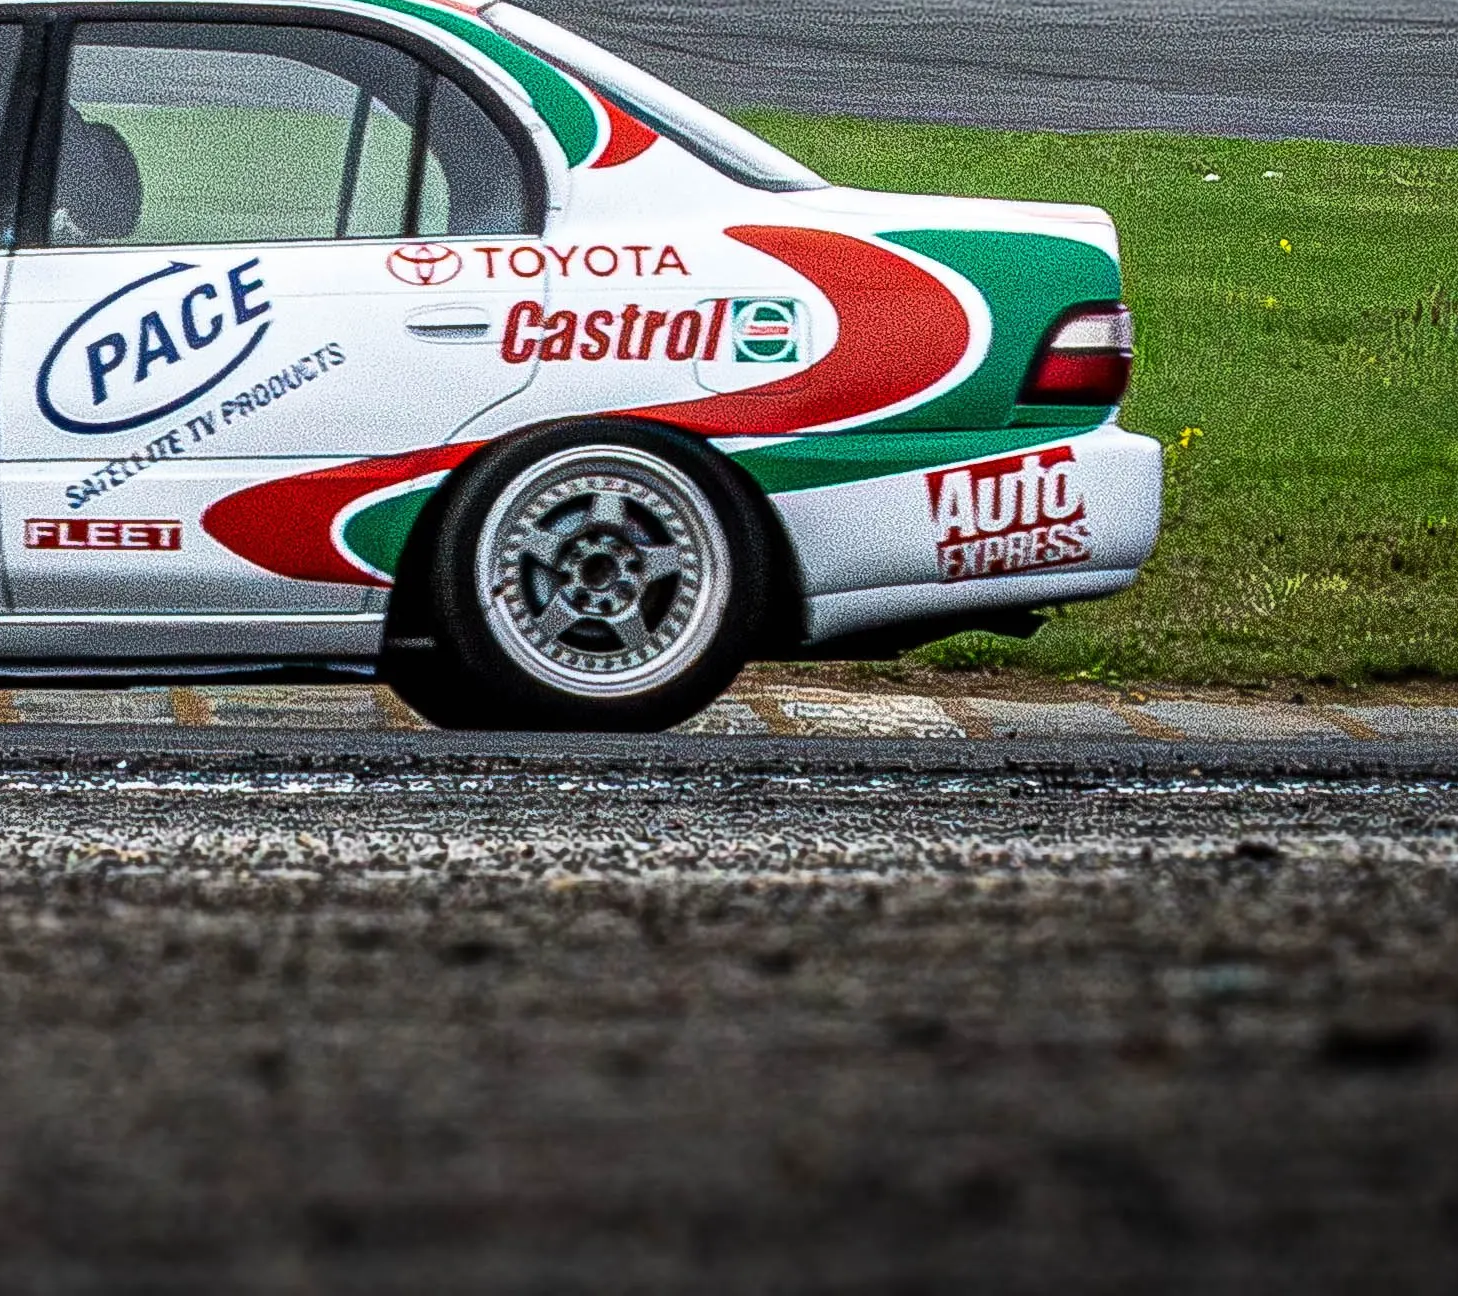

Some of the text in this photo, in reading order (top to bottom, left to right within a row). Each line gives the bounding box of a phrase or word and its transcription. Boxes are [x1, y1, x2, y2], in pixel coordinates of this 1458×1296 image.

[473, 244, 692, 278] TOYOTA
[83, 256, 272, 407] PACE
[500, 298, 731, 364] Castrol
[65, 342, 348, 510] SATELLITE TV PRODUCTS
[26, 520, 179, 548] FLEET
[941, 523, 1090, 580] EXPRESS
